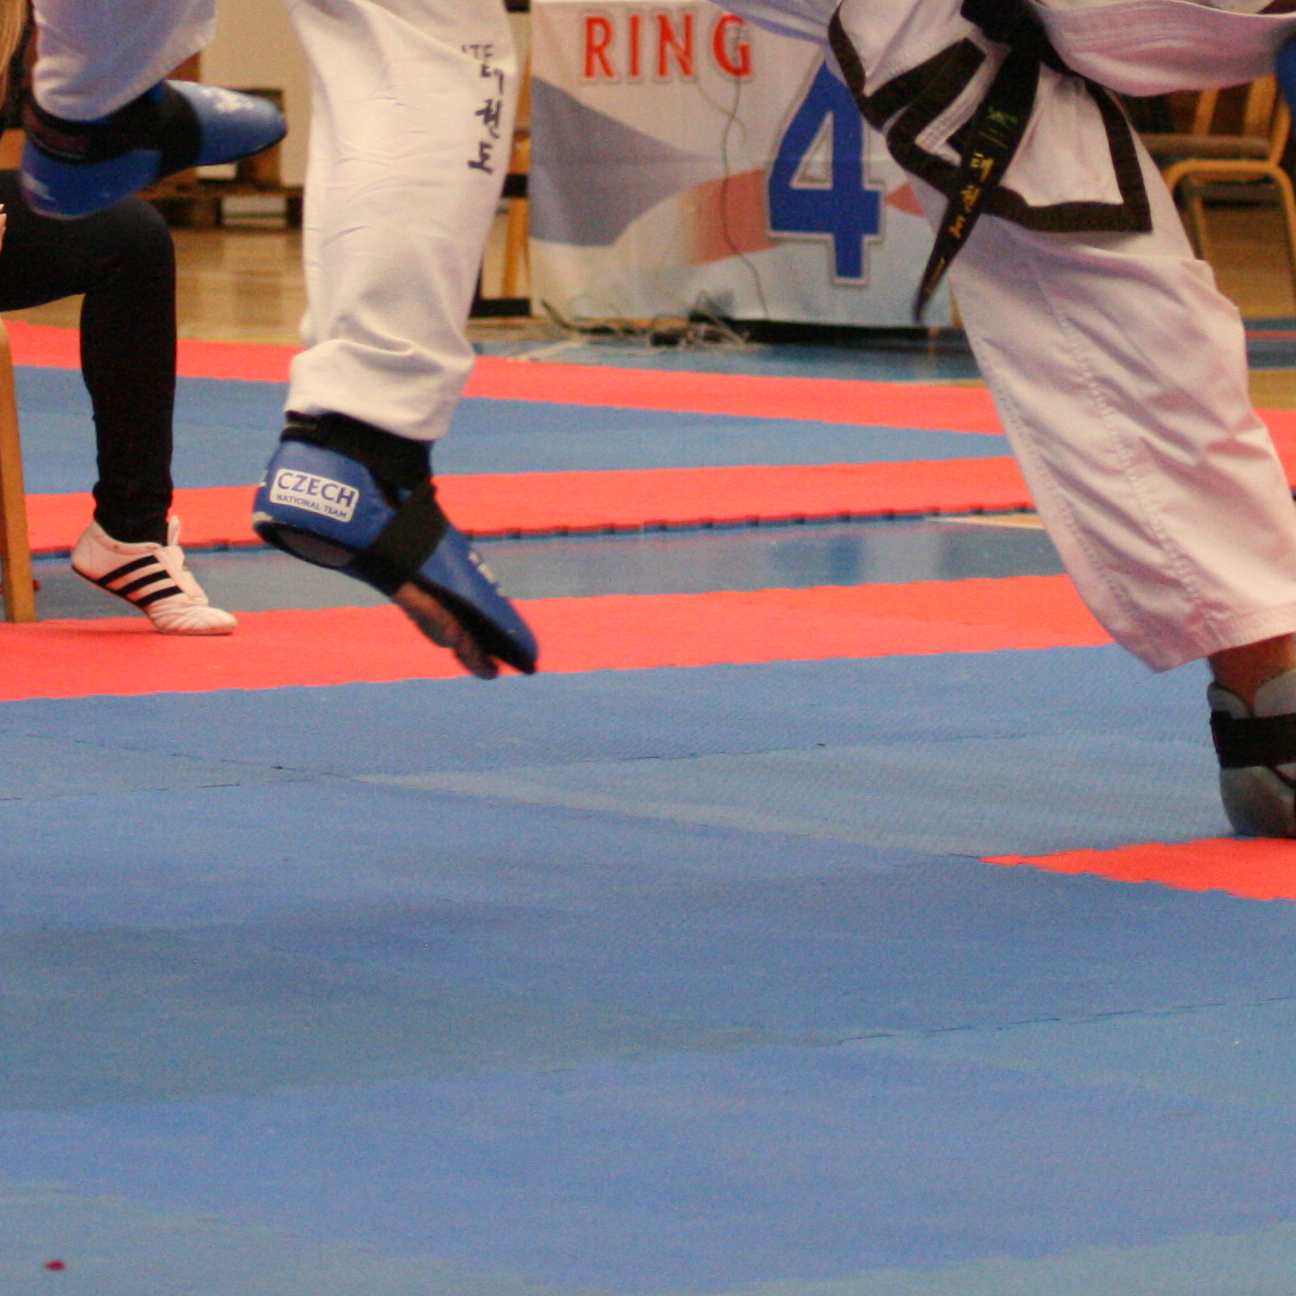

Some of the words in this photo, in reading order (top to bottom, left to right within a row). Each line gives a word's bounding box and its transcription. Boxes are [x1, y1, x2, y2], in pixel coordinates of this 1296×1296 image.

[583, 14, 752, 79] RING
[768, 59, 882, 279] 4
[276, 493, 321, 512] NATIONAL
[323, 504, 347, 519] TEAM
[277, 471, 356, 509] CZECH
